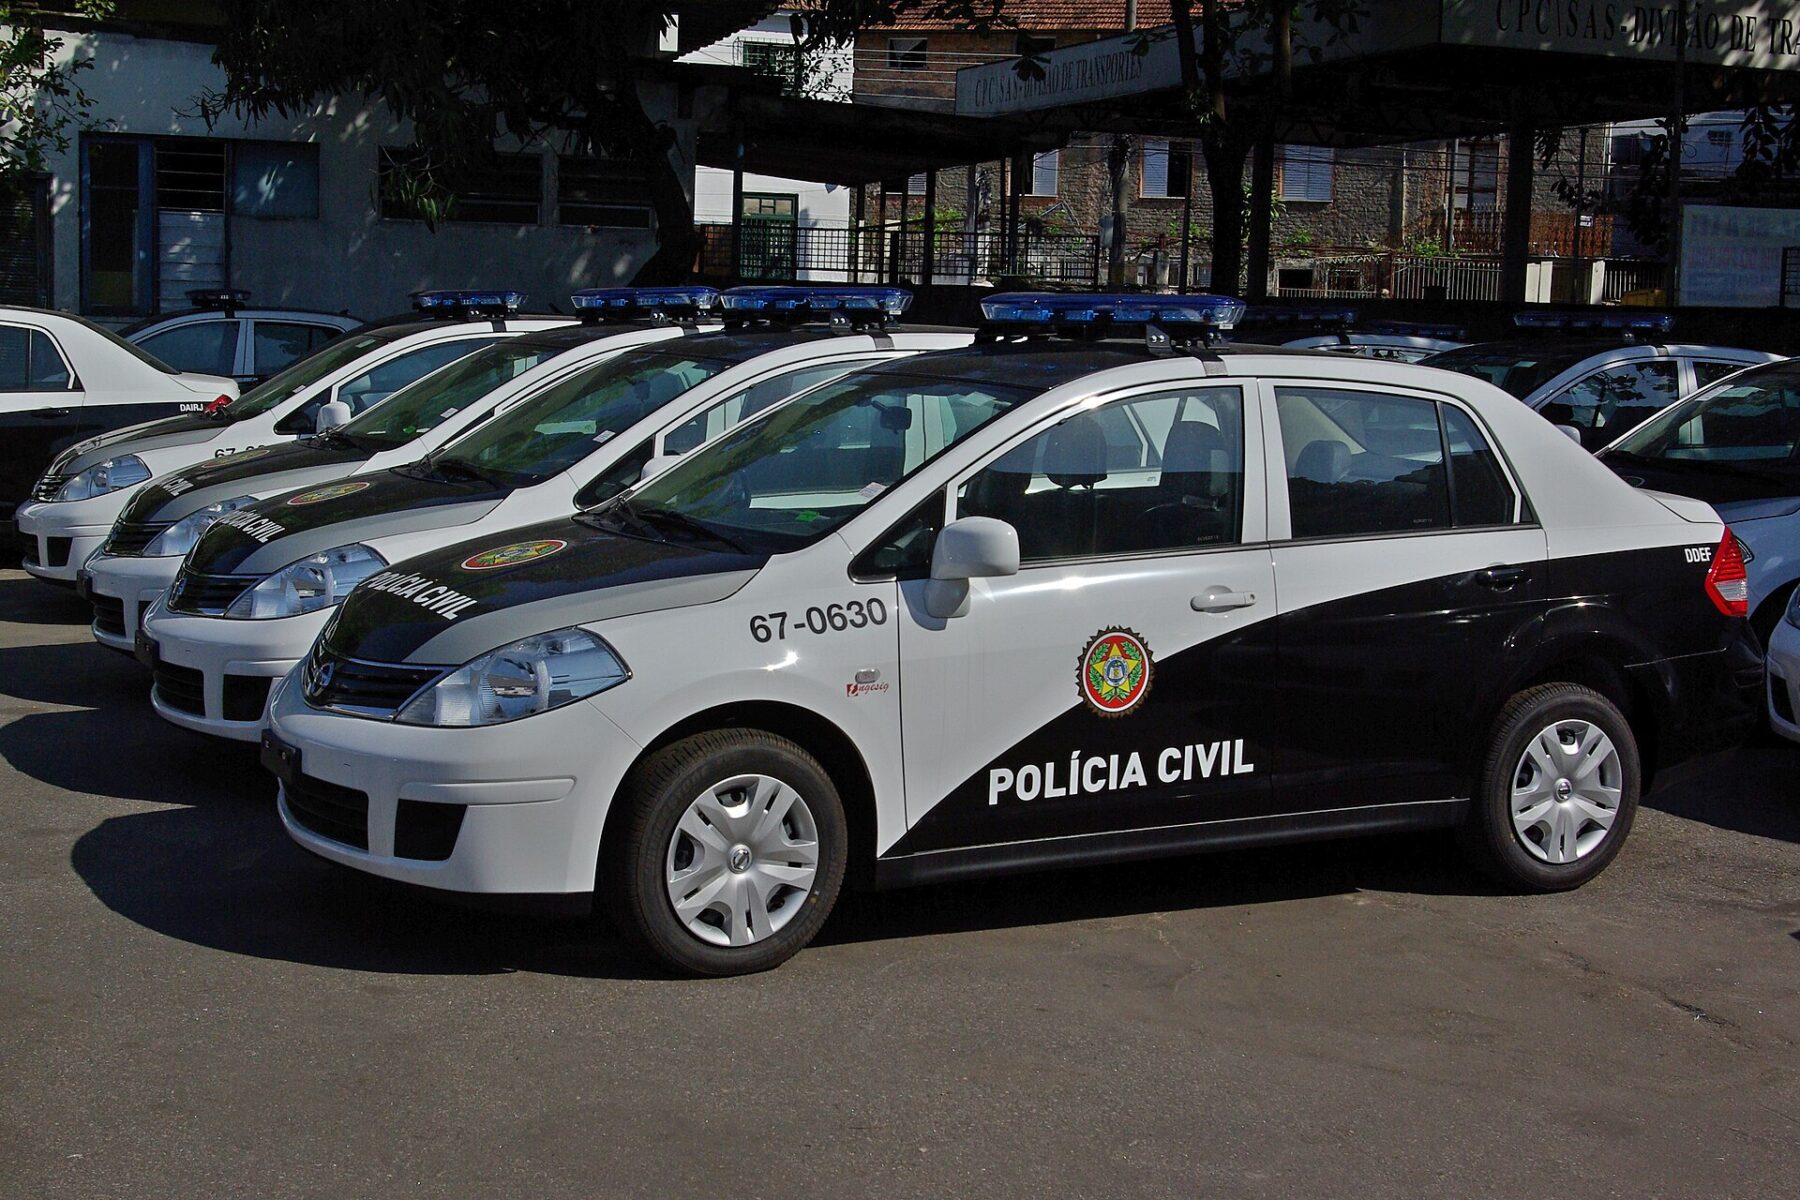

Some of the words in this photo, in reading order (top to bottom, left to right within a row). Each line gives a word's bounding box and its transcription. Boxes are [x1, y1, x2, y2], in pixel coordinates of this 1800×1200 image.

[1728, 15, 1756, 52] DE
[1061, 60, 1073, 91] DE
[1075, 50, 1142, 89] TRANSPORTES
[180, 403, 204, 412] DAIRJ
[242, 518, 286, 544] CIVIL
[1684, 547, 1712, 563] DDEF
[358, 571, 434, 599] POLÍCIA
[412, 585, 478, 621] CIVIL
[749, 597, 887, 643] 67-0630
[988, 750, 1148, 806] POLÍCIA
[1157, 738, 1255, 783] CIVIL
